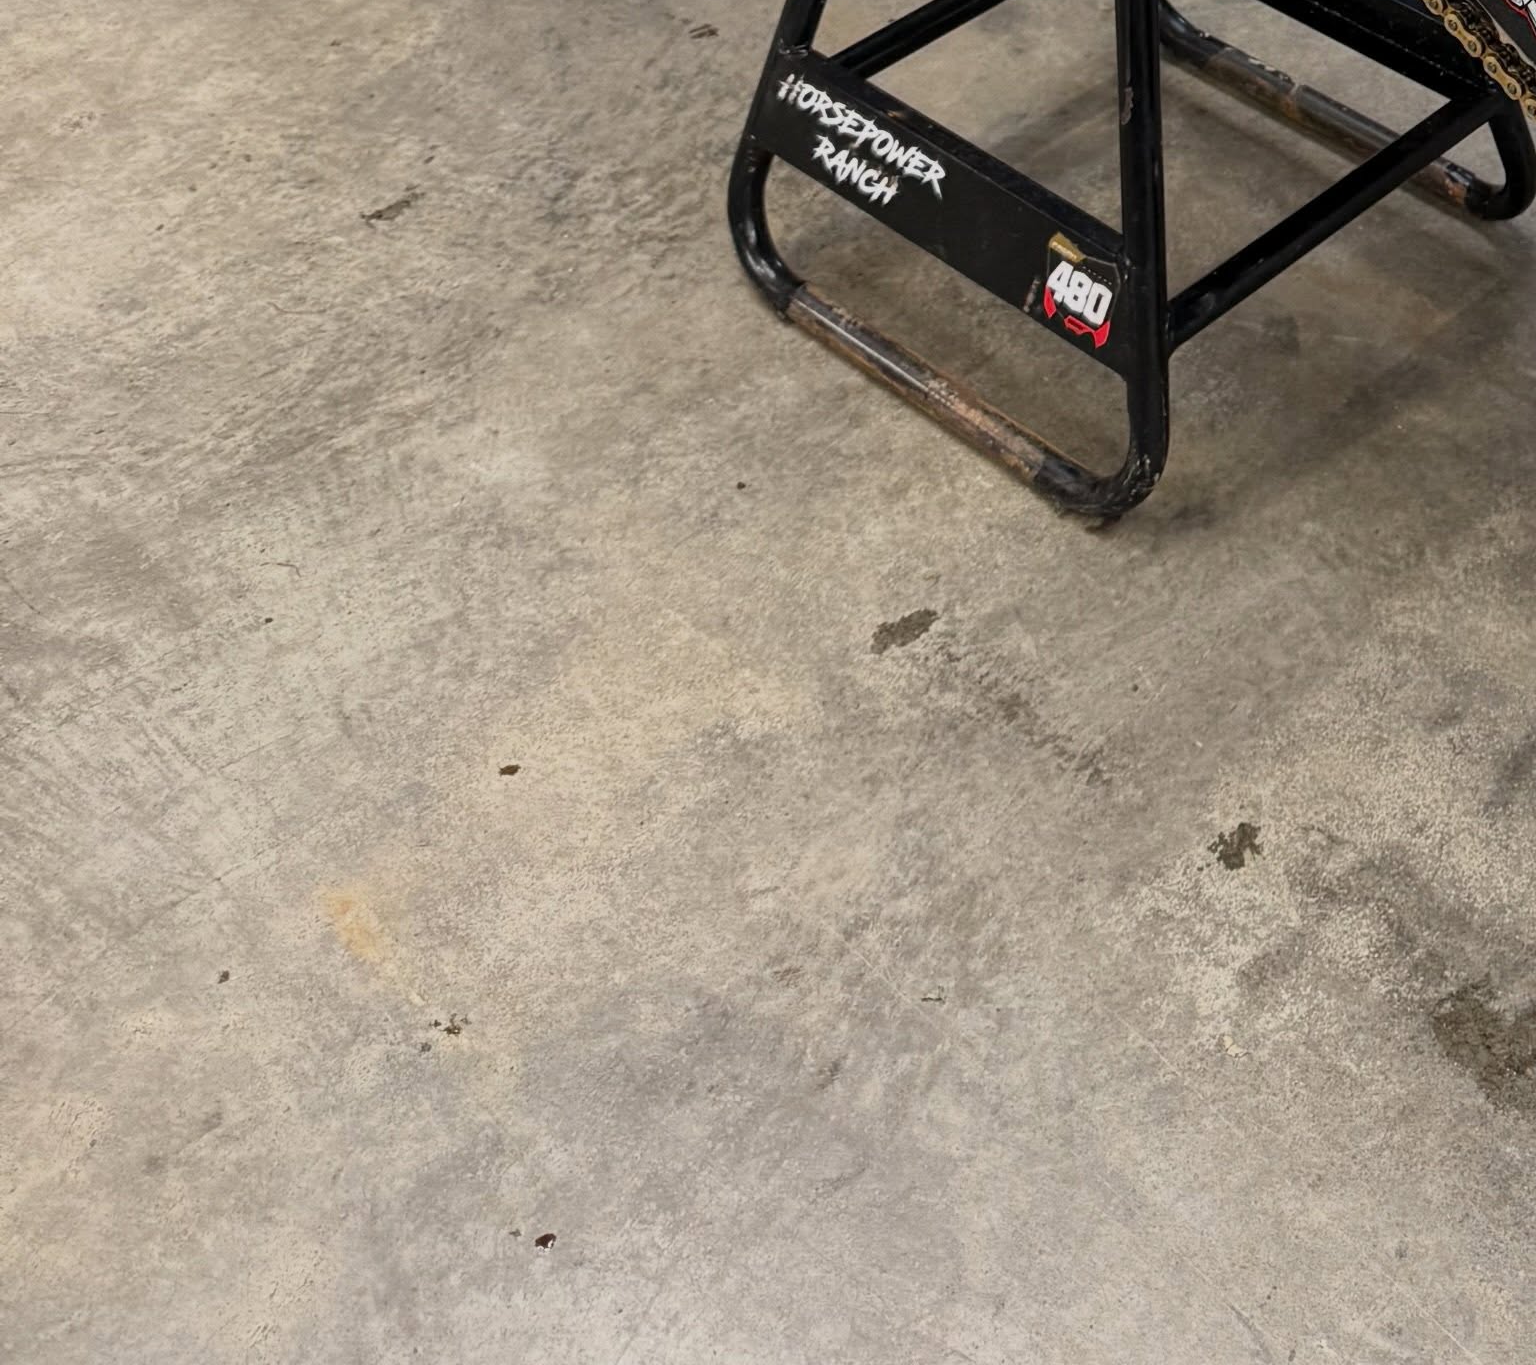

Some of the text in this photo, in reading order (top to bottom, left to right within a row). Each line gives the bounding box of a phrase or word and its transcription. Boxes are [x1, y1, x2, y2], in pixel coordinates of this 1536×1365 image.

[778, 73, 946, 200] HORSEPOWER
[811, 133, 898, 205] RANCH
[1045, 260, 1113, 327] 480
